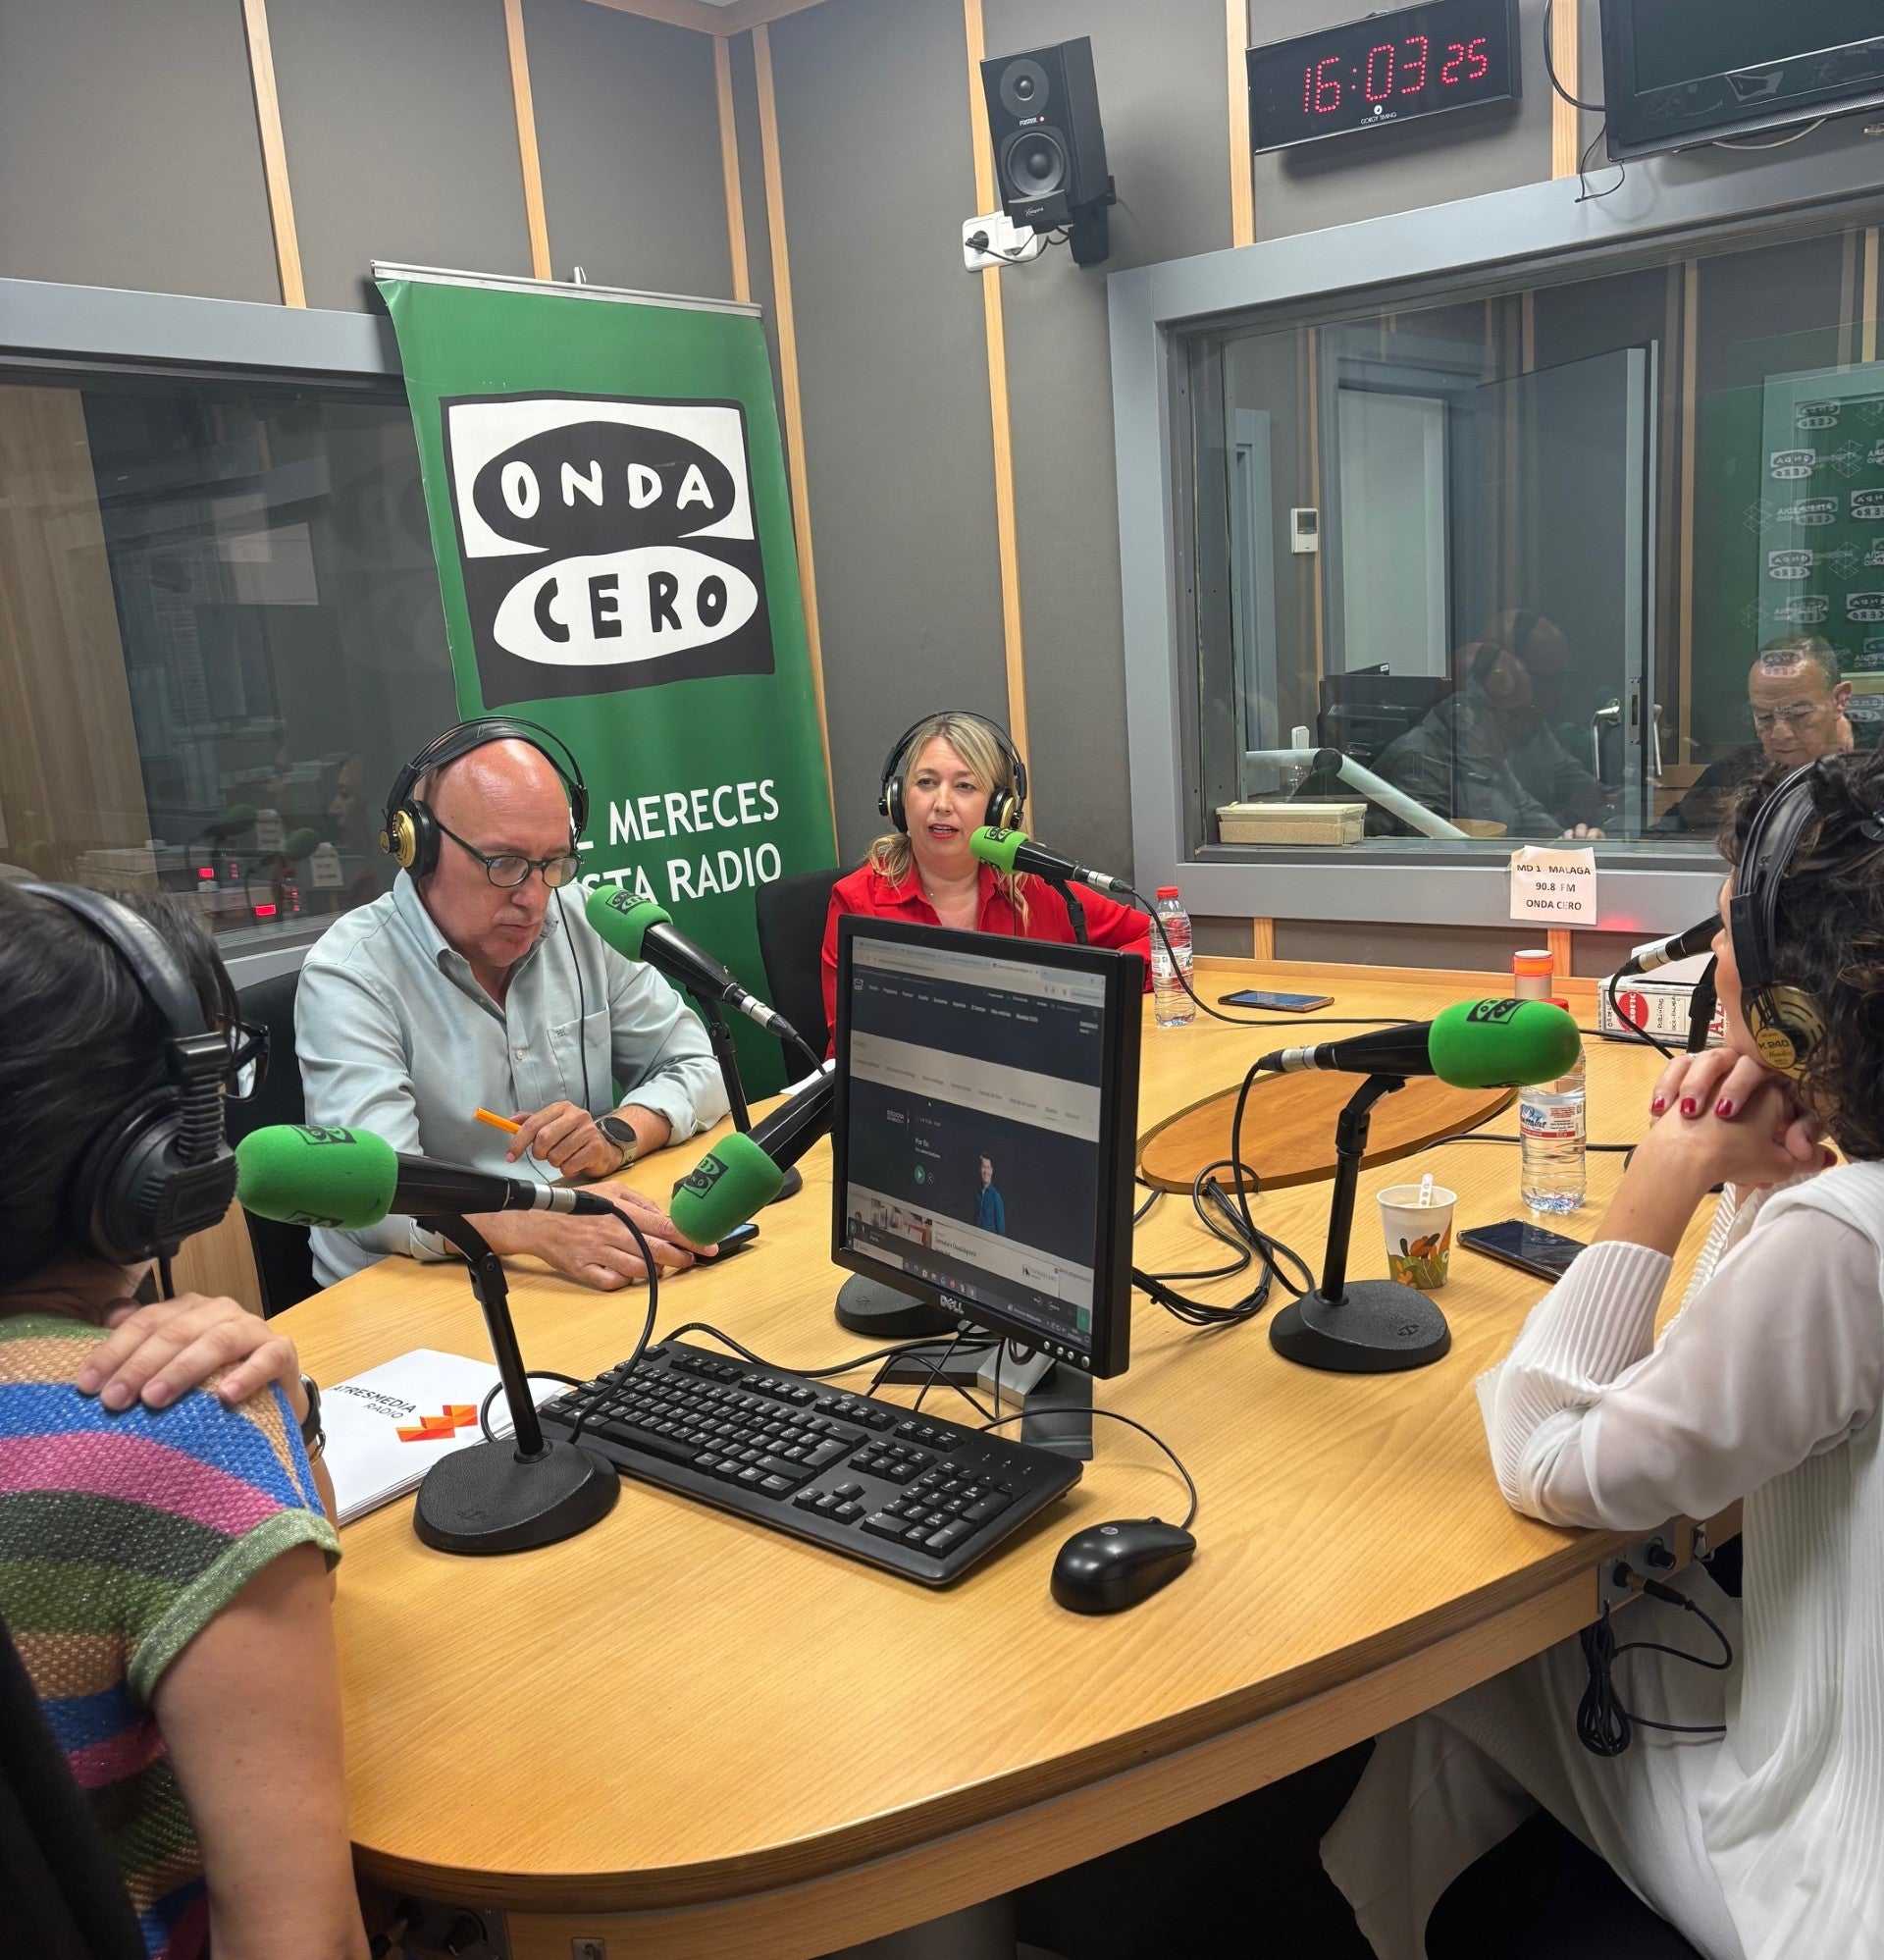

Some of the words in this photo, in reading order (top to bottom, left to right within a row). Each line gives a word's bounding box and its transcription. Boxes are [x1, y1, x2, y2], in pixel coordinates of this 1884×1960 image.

[1303, 35, 1429, 113] 16:03
[1441, 36, 1488, 85] 25
[500, 459, 714, 519] ONDA
[534, 570, 728, 643] CERO
[609, 778, 780, 846] MERECES
[666, 842, 781, 903] RADIO
[1516, 864, 1534, 873] MD
[1548, 866, 1592, 875] MALAGA
[1535, 881, 1556, 891] 90.8
[1560, 883, 1576, 892] FM
[1526, 899, 1554, 909] ONDA
[1556, 901, 1582, 911] CERO
[940, 1294, 965, 1315] DELL
[329, 1385, 417, 1413] ATRESMEDIA
[363, 1403, 404, 1419] RADIO
